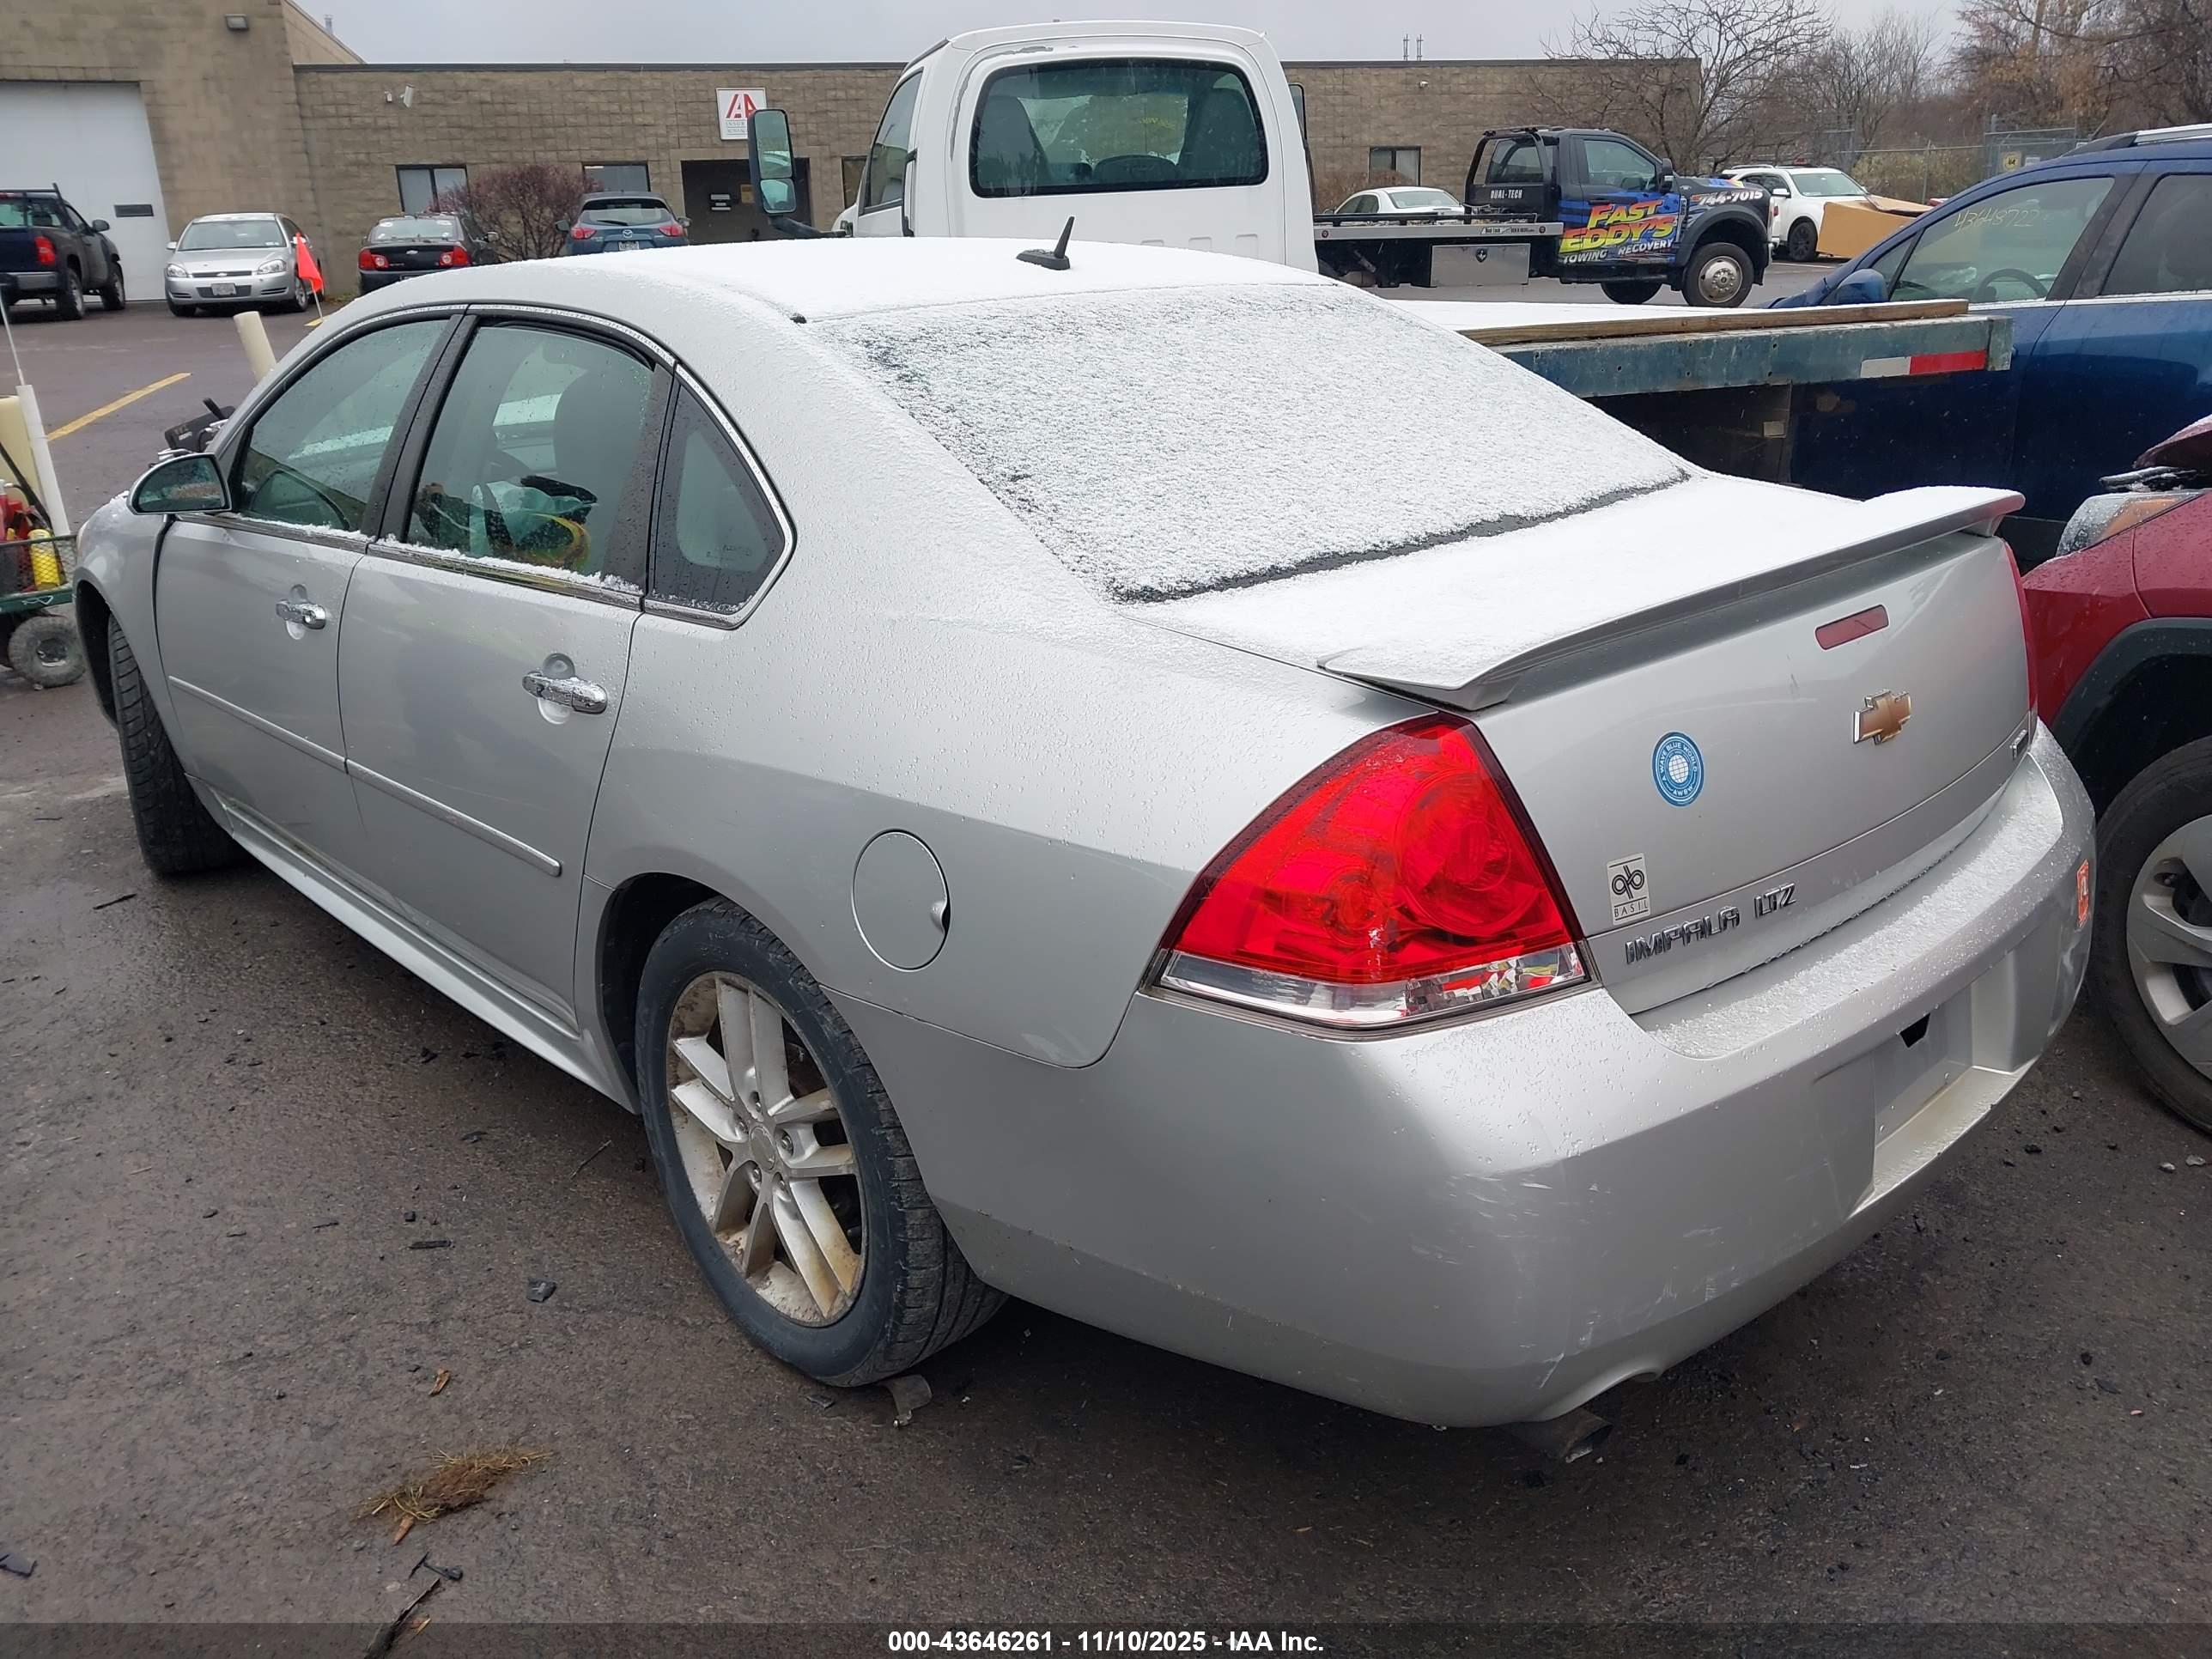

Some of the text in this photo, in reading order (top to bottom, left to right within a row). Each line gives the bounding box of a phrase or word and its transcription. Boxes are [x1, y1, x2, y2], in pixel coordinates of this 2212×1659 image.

[1698, 190, 1764, 206] 744-7015
[1587, 199, 1664, 228] FAST
[1559, 216, 1676, 254] EDDY'S
[1563, 239, 1674, 264] TOWING RECOVERY
[1667, 742, 1682, 750] BLUE
[1683, 745, 1697, 772] WORLD
[1614, 900, 1649, 918] BASIL
[1625, 883, 1797, 964] IMPALA LTZ
